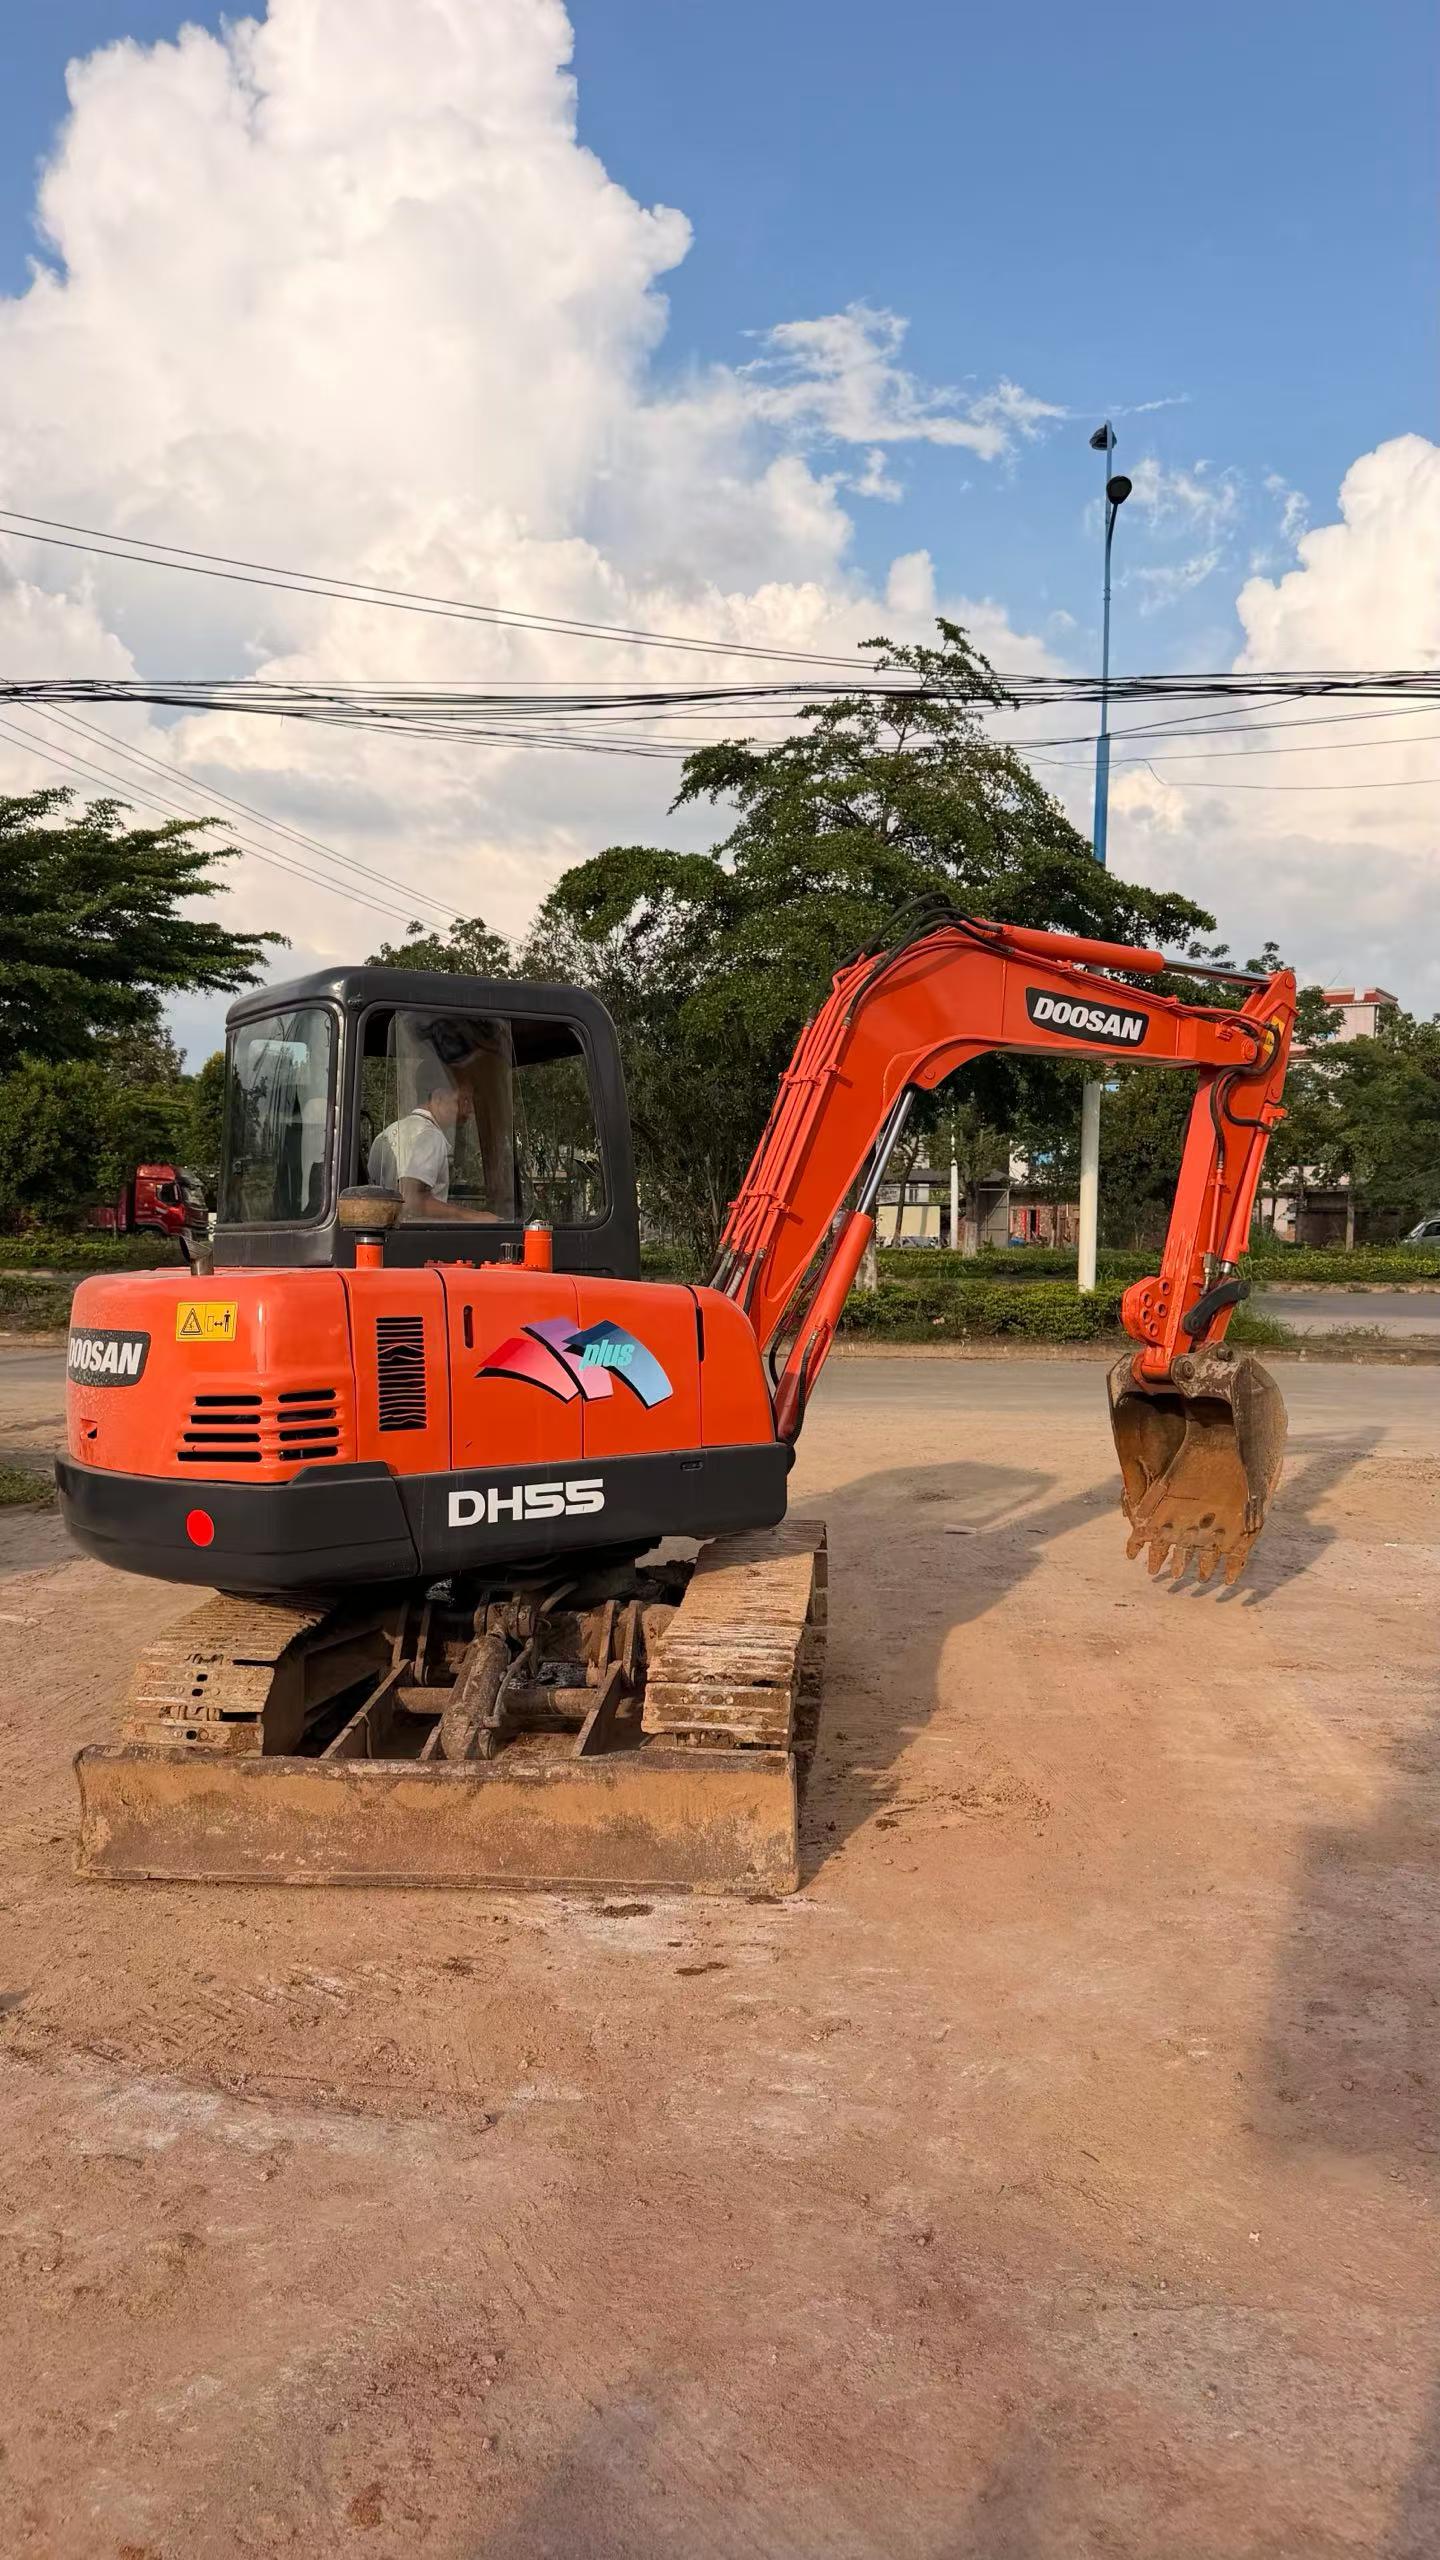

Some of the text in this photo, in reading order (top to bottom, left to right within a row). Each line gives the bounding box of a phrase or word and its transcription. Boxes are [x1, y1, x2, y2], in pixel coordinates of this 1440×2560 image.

[1033, 997, 1143, 1040] DOOSAN
[69, 1337, 143, 1375] DOOSAN
[579, 1339, 635, 1371] plus
[448, 1478, 605, 1527] DH55
